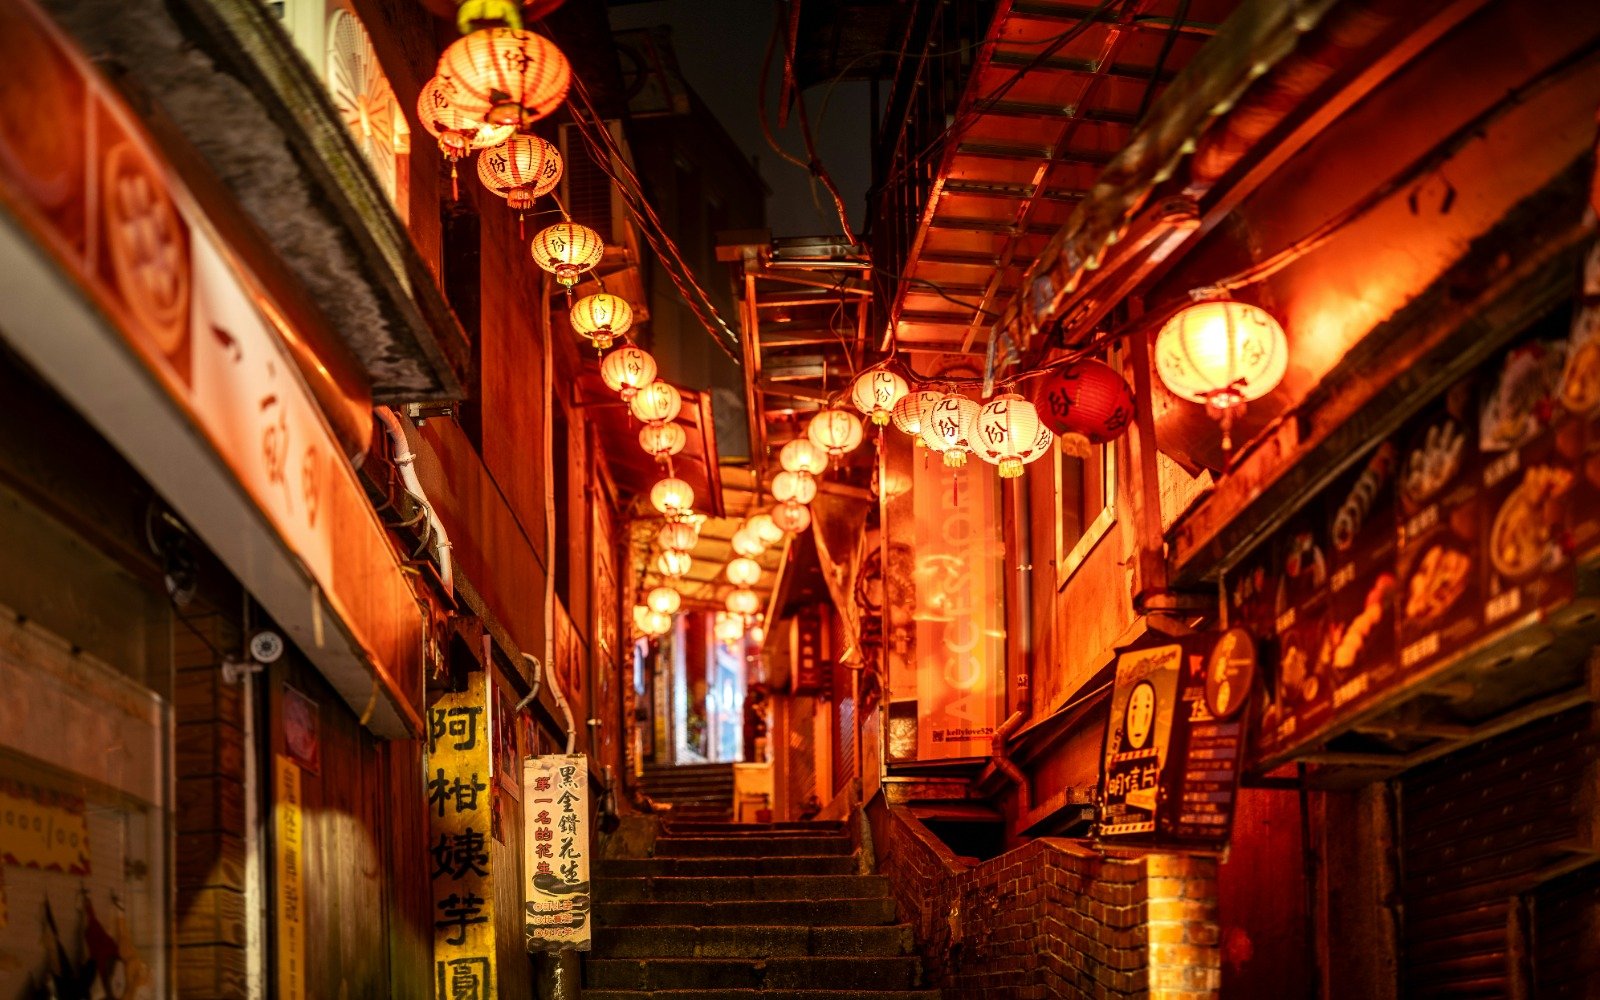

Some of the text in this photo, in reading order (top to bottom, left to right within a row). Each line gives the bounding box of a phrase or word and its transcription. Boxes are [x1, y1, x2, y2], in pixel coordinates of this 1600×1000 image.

[875, 372, 892, 403] 九份
[936, 399, 958, 438] 九份
[974, 400, 1008, 445] 九份
[533, 776, 554, 875] 第一名的花生
[556, 765, 582, 884] 黑金鑽花生
